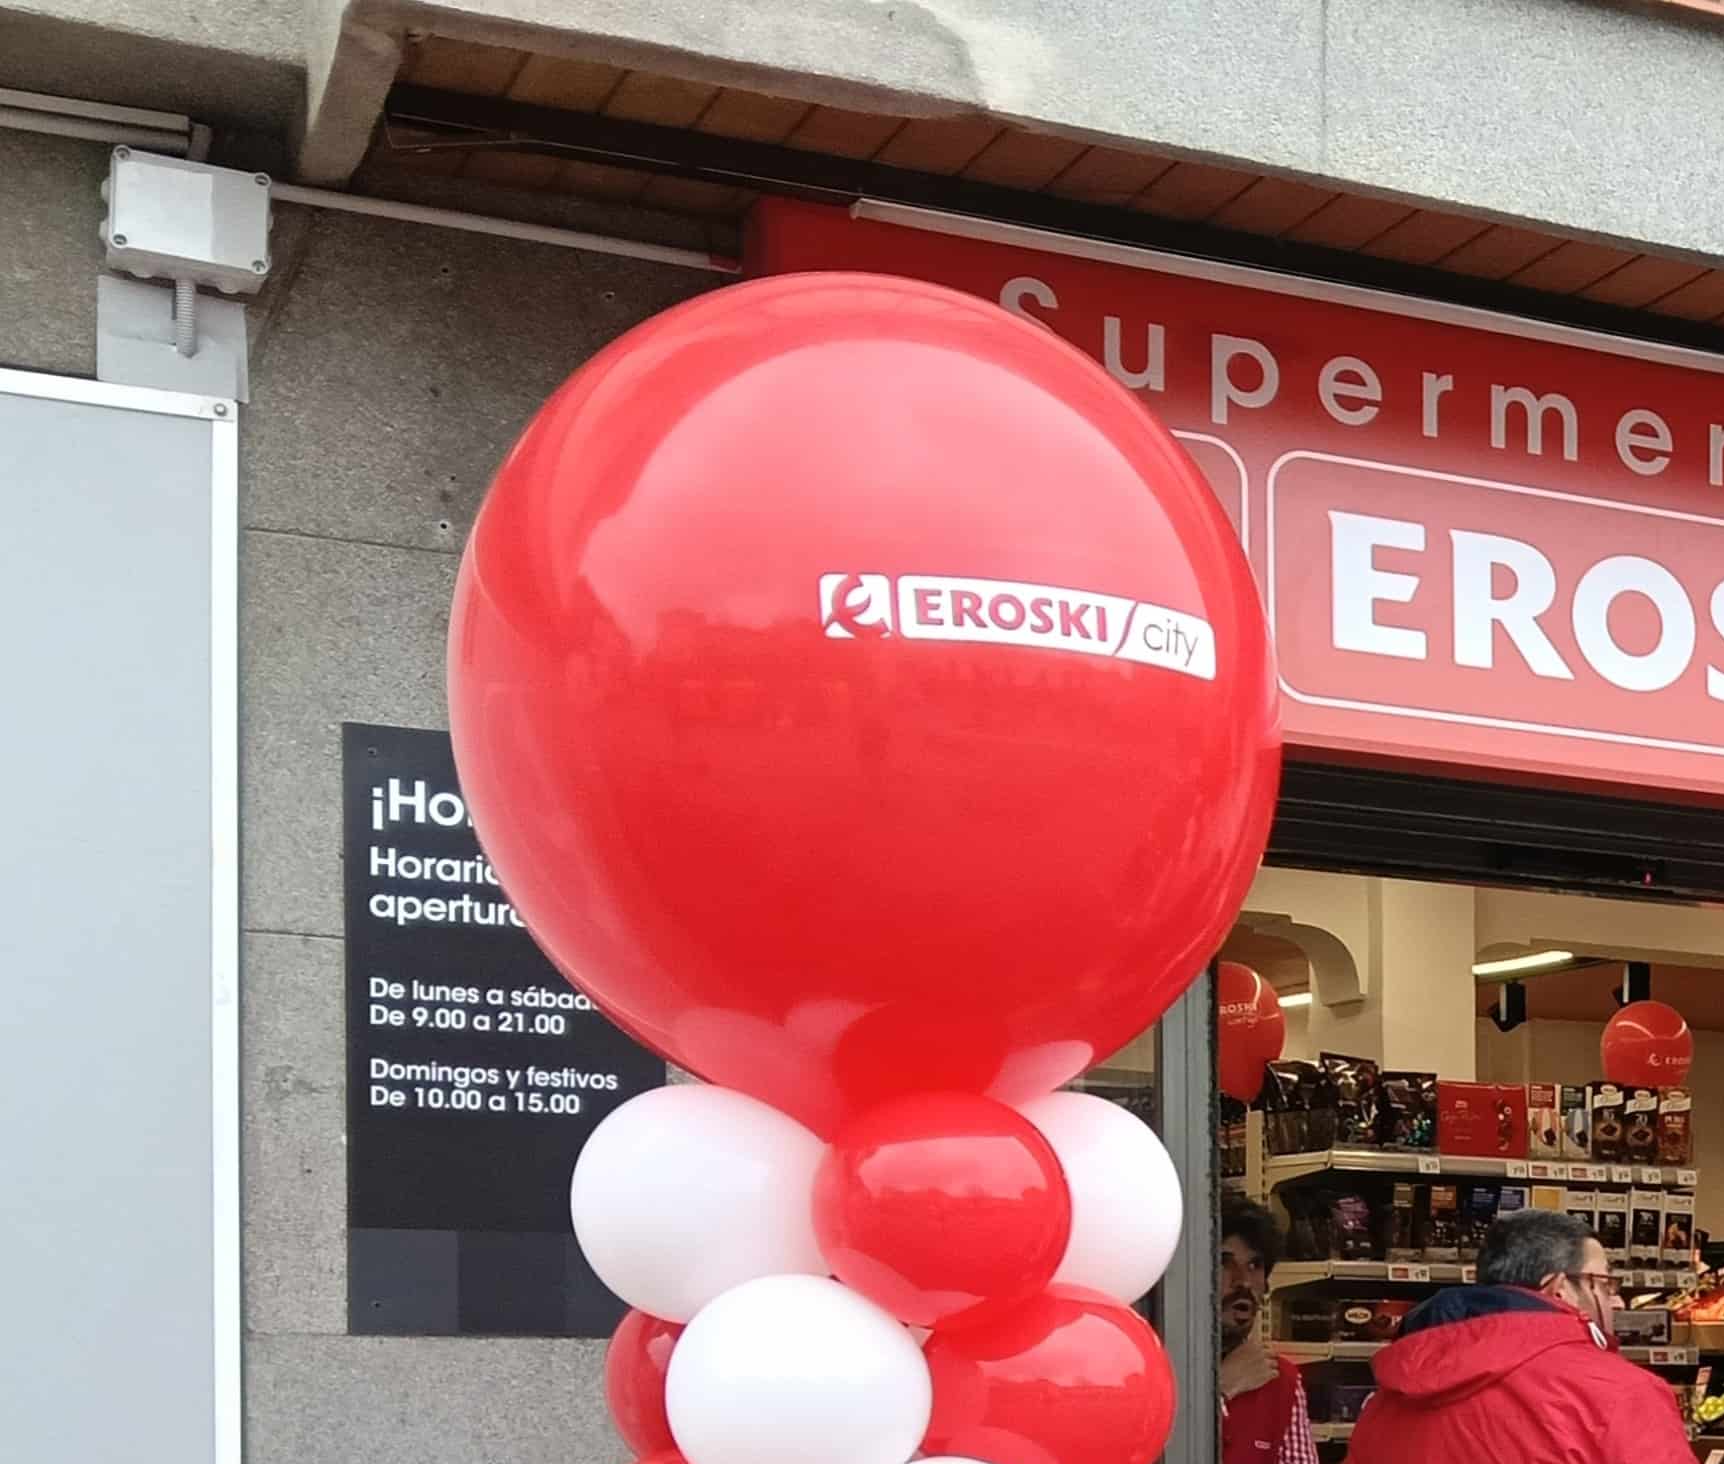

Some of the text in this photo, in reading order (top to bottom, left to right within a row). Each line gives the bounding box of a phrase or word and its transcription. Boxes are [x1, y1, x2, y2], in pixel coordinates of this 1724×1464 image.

[913, 587, 1199, 668] EROSKI city
[372, 778, 473, 831] ¡Ho
[369, 977, 406, 1000] De
[412, 980, 480, 1004] lunes
[486, 987, 504, 1006] a
[369, 1004, 566, 1035] De 9.00 a 21.00
[370, 1058, 619, 1091] Domingos y festivos
[370, 1085, 581, 1115] De 10.00 a 15.00
